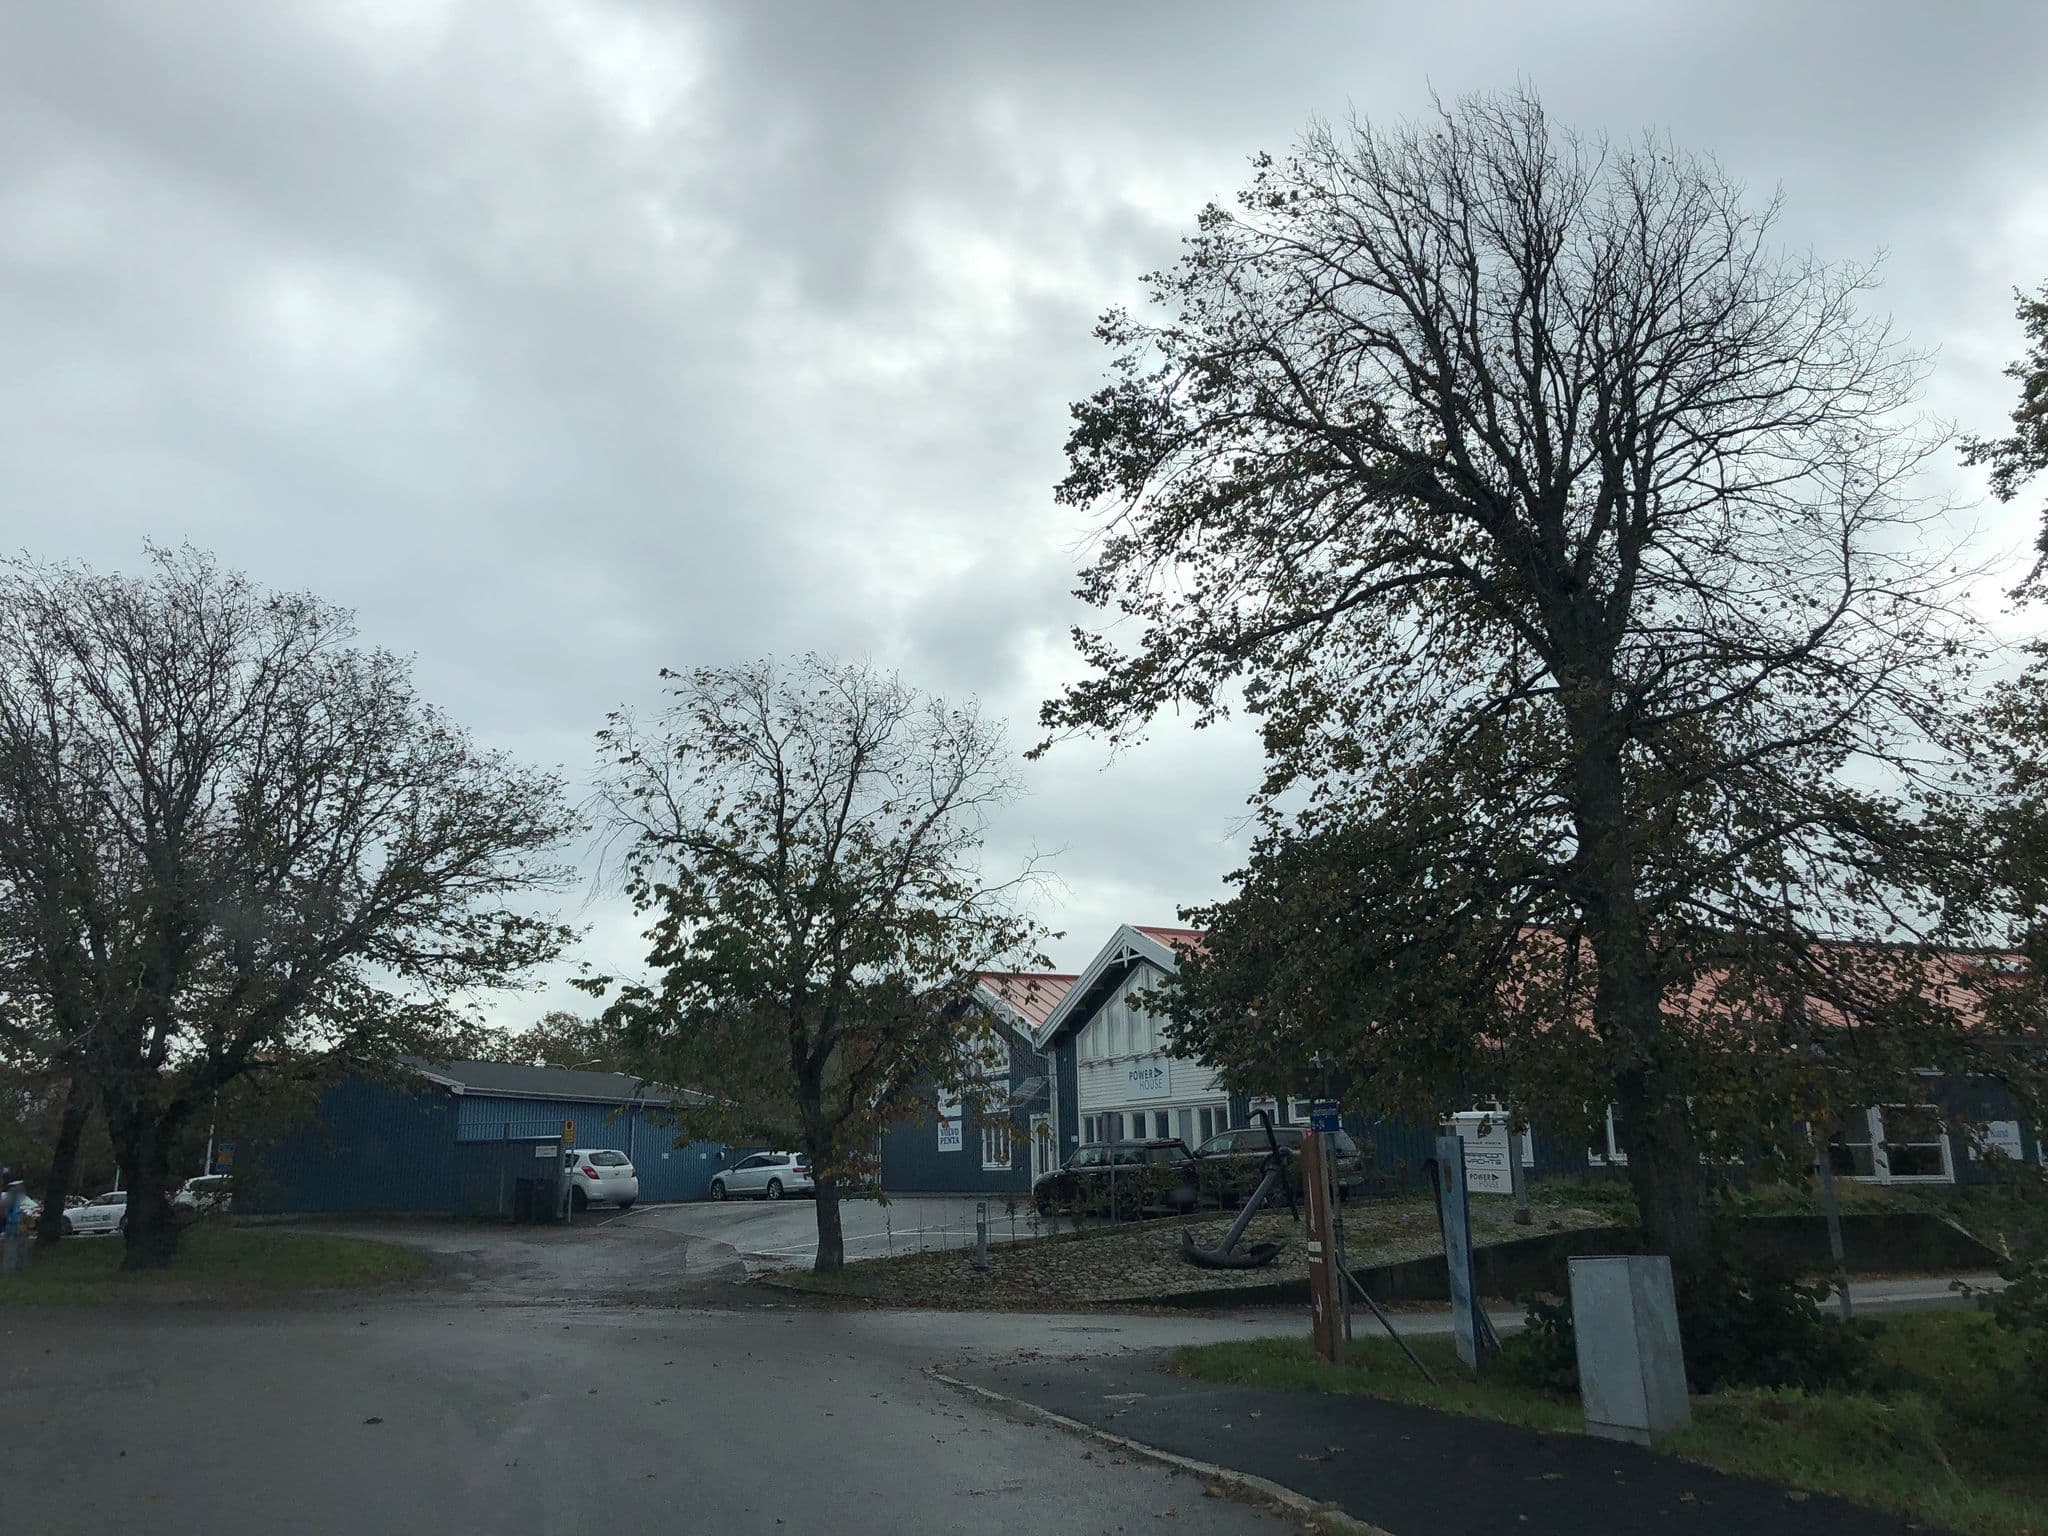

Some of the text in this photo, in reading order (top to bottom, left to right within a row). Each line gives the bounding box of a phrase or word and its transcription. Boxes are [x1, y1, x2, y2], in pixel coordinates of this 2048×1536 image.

[1128, 1069, 1153, 1081] POWER
[1139, 1079, 1162, 1090] HOUSE
[939, 1127, 960, 1137] VOLVO
[939, 1135, 960, 1145] PENTA
[1469, 1173, 1491, 1181] POWER
